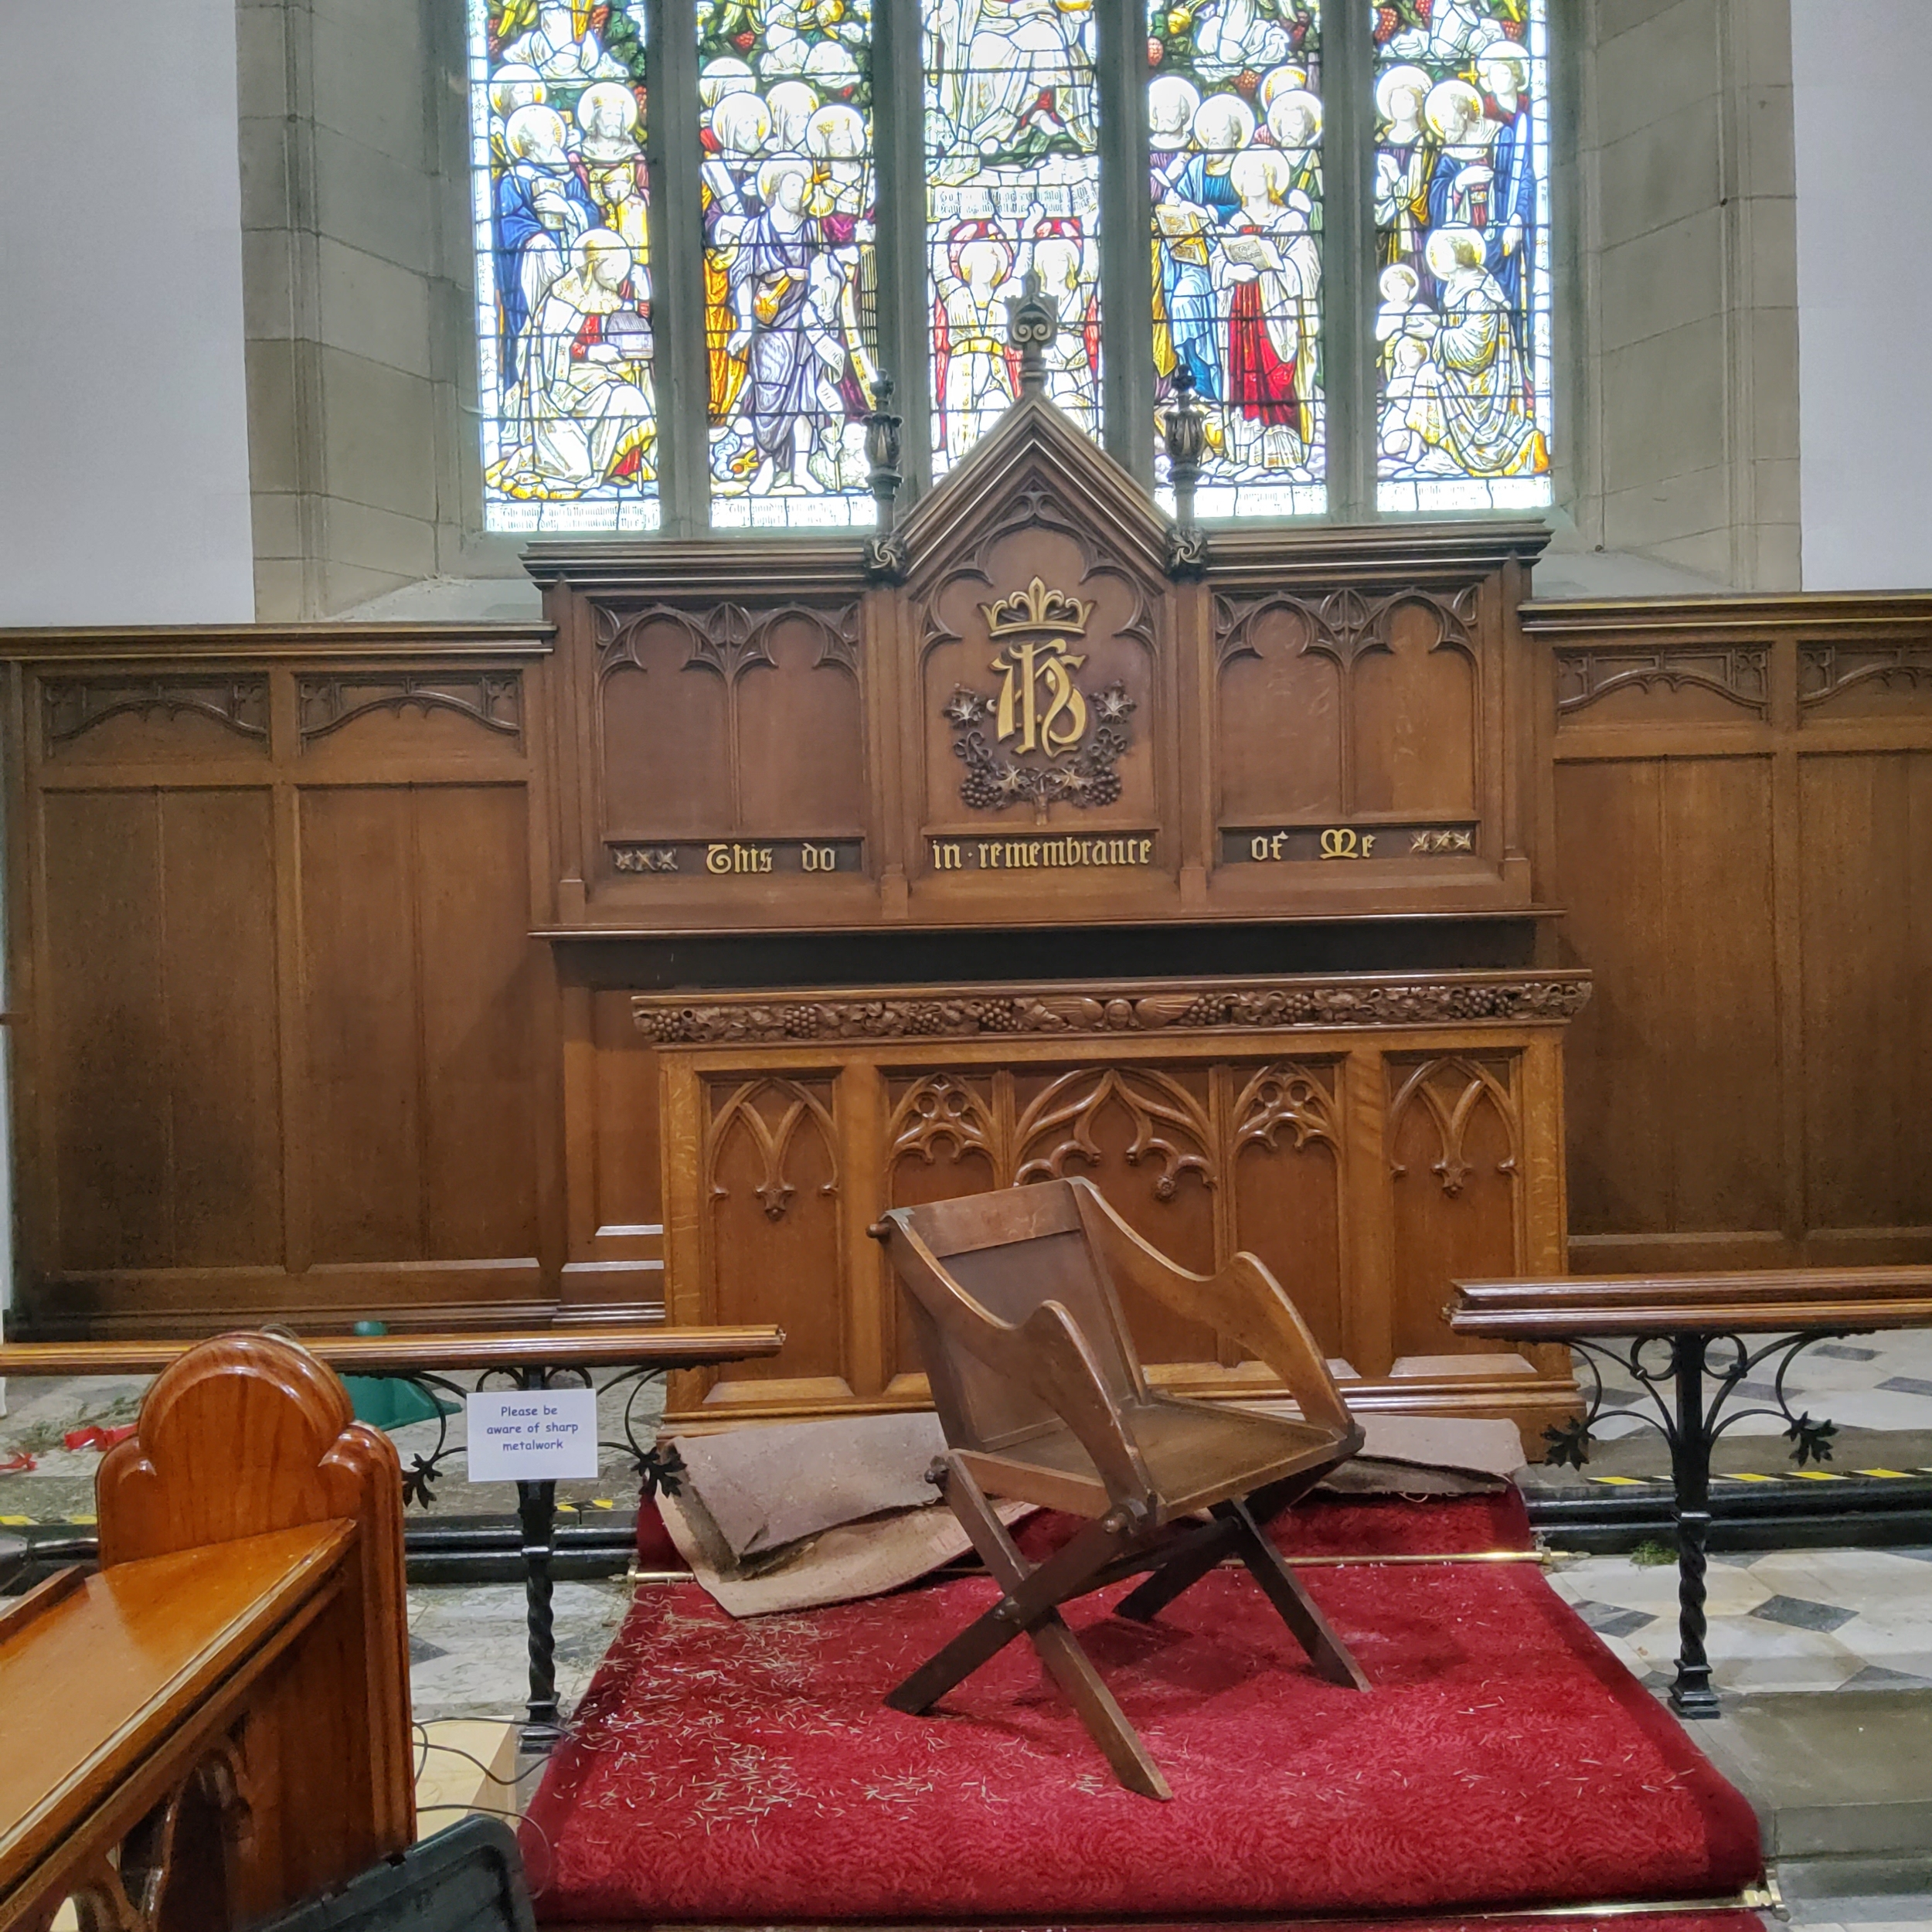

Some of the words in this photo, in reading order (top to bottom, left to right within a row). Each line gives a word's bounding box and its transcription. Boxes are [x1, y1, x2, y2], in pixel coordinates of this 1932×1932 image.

[932, 839, 962, 869] in
[978, 837, 1152, 869] remembrance
[1250, 830, 1289, 861] of
[1319, 828, 1376, 859] Me
[706, 843, 773, 875] This
[801, 842, 835, 872] do
[501, 1406, 538, 1417] Please
[543, 1405, 558, 1416] be
[486, 1424, 522, 1434] aware
[527, 1422, 540, 1433] of
[546, 1422, 579, 1434] sharp
[502, 1438, 563, 1451] metalwork
